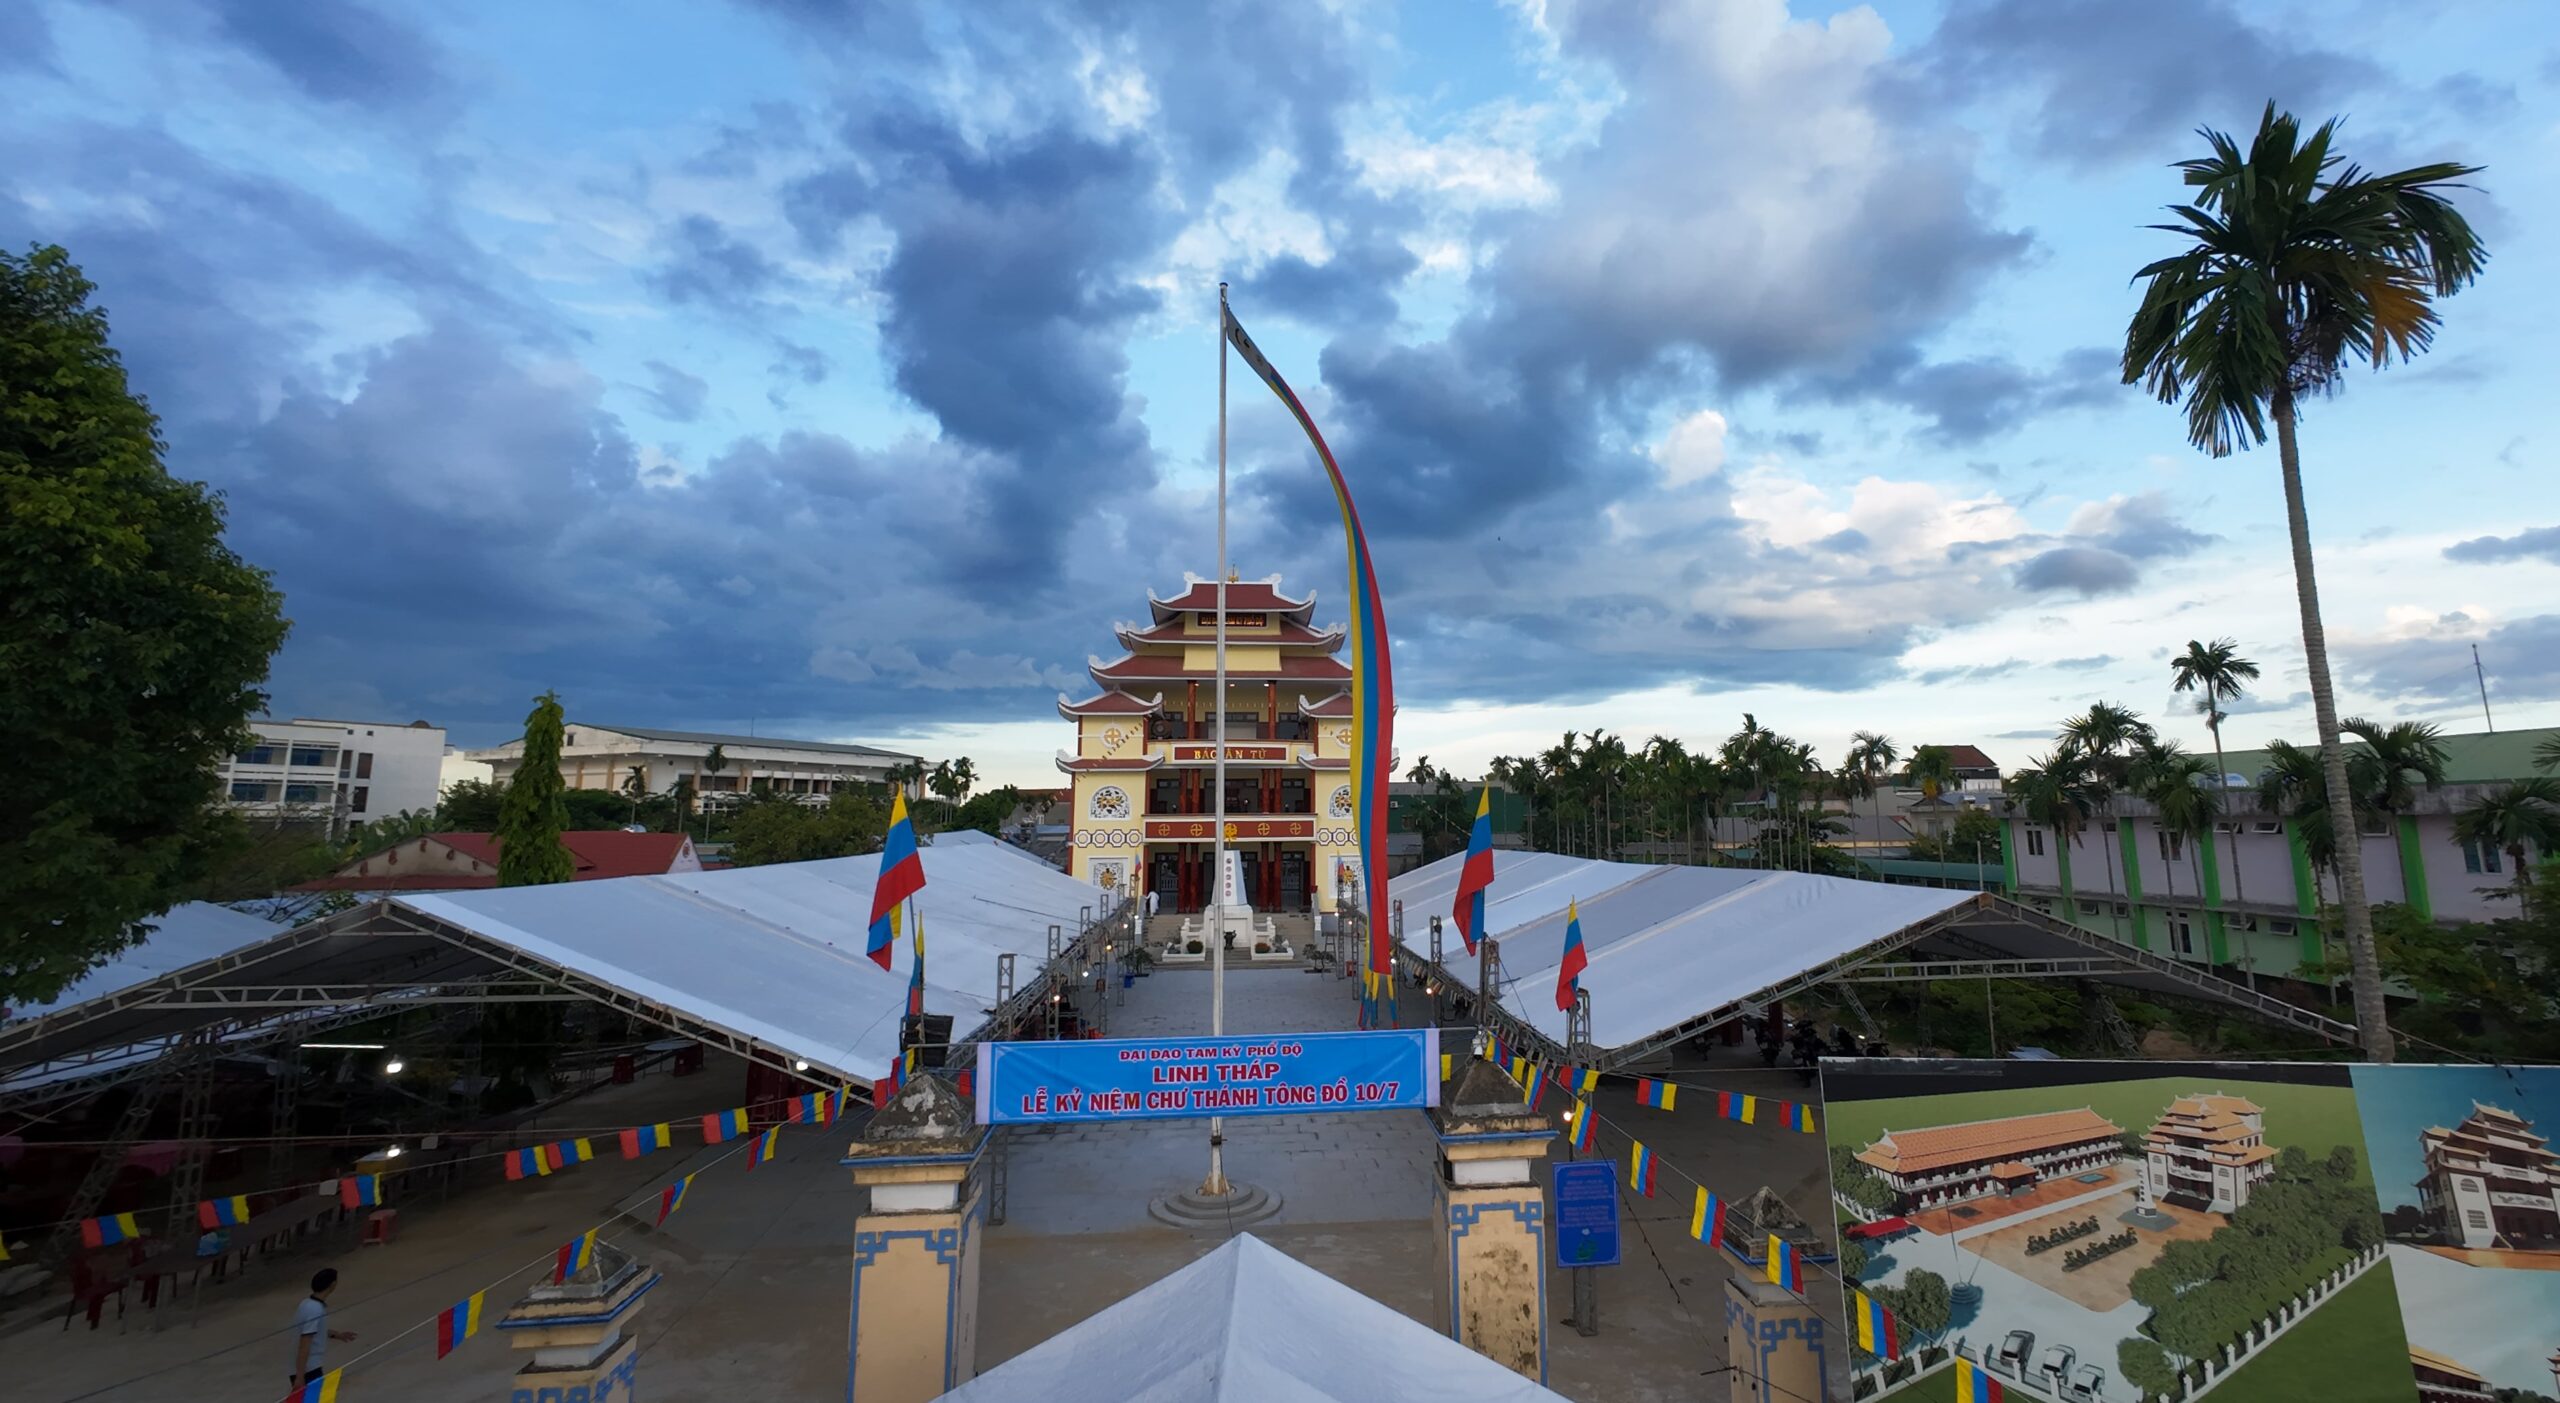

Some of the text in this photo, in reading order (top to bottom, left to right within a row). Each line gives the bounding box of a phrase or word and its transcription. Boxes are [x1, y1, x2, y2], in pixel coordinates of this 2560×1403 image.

[1120, 1050, 1146, 1062] ĐẠI
[1151, 1048, 1181, 1061] ĐẠO
[1187, 1047, 1217, 1058] TAM
[1282, 1042, 1302, 1056] ĐỘ
[1153, 1060, 1280, 1083] LINH THÁP
[1023, 1077, 1399, 1115] LỄ KỶ NIỆM CHƯ THÁNH TÔNG ĐỒ 10/7
